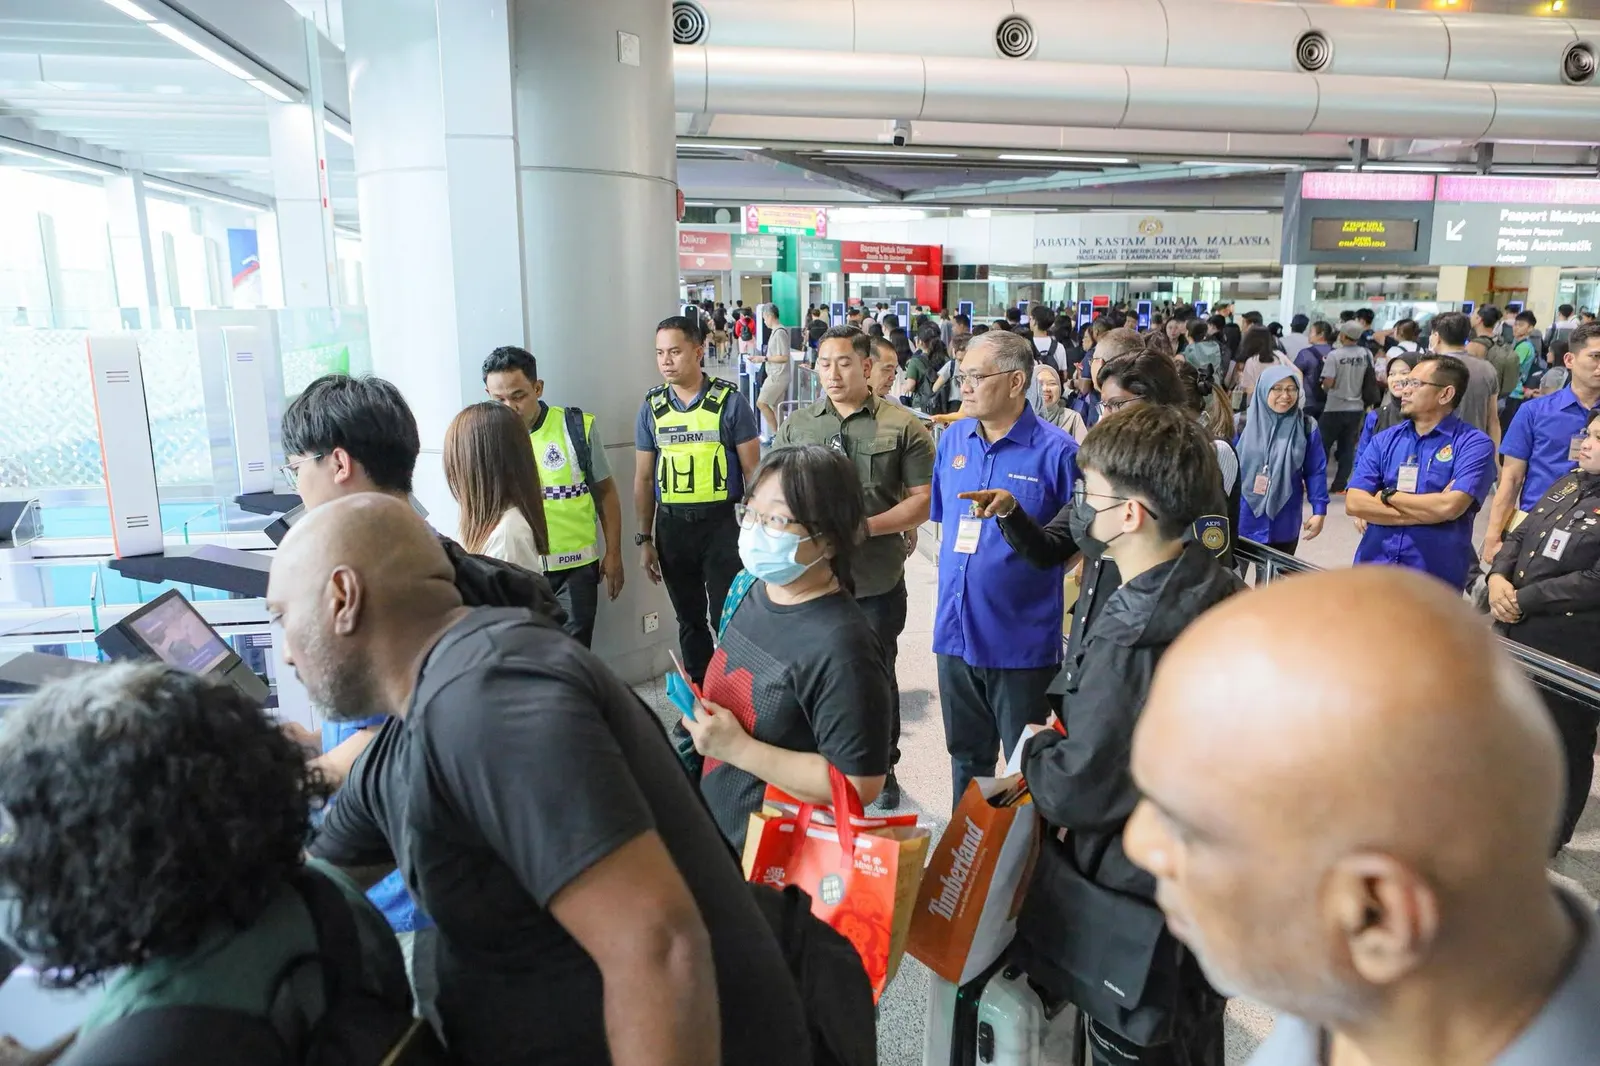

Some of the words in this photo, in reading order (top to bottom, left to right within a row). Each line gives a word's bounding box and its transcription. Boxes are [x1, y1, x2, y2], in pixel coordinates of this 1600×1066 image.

[1500, 209, 1547, 224] Pasport
[1034, 238, 1087, 248] JABATAN
[1095, 237, 1146, 246] KASTAM
[1155, 236, 1198, 247] DIRAJA
[1207, 236, 1271, 246] MALAYSIA
[1530, 239, 1592, 252] Automatik
[671, 433, 704, 443] PDRM
[559, 554, 582, 564] PDRM
[928, 815, 984, 922] Timberland
